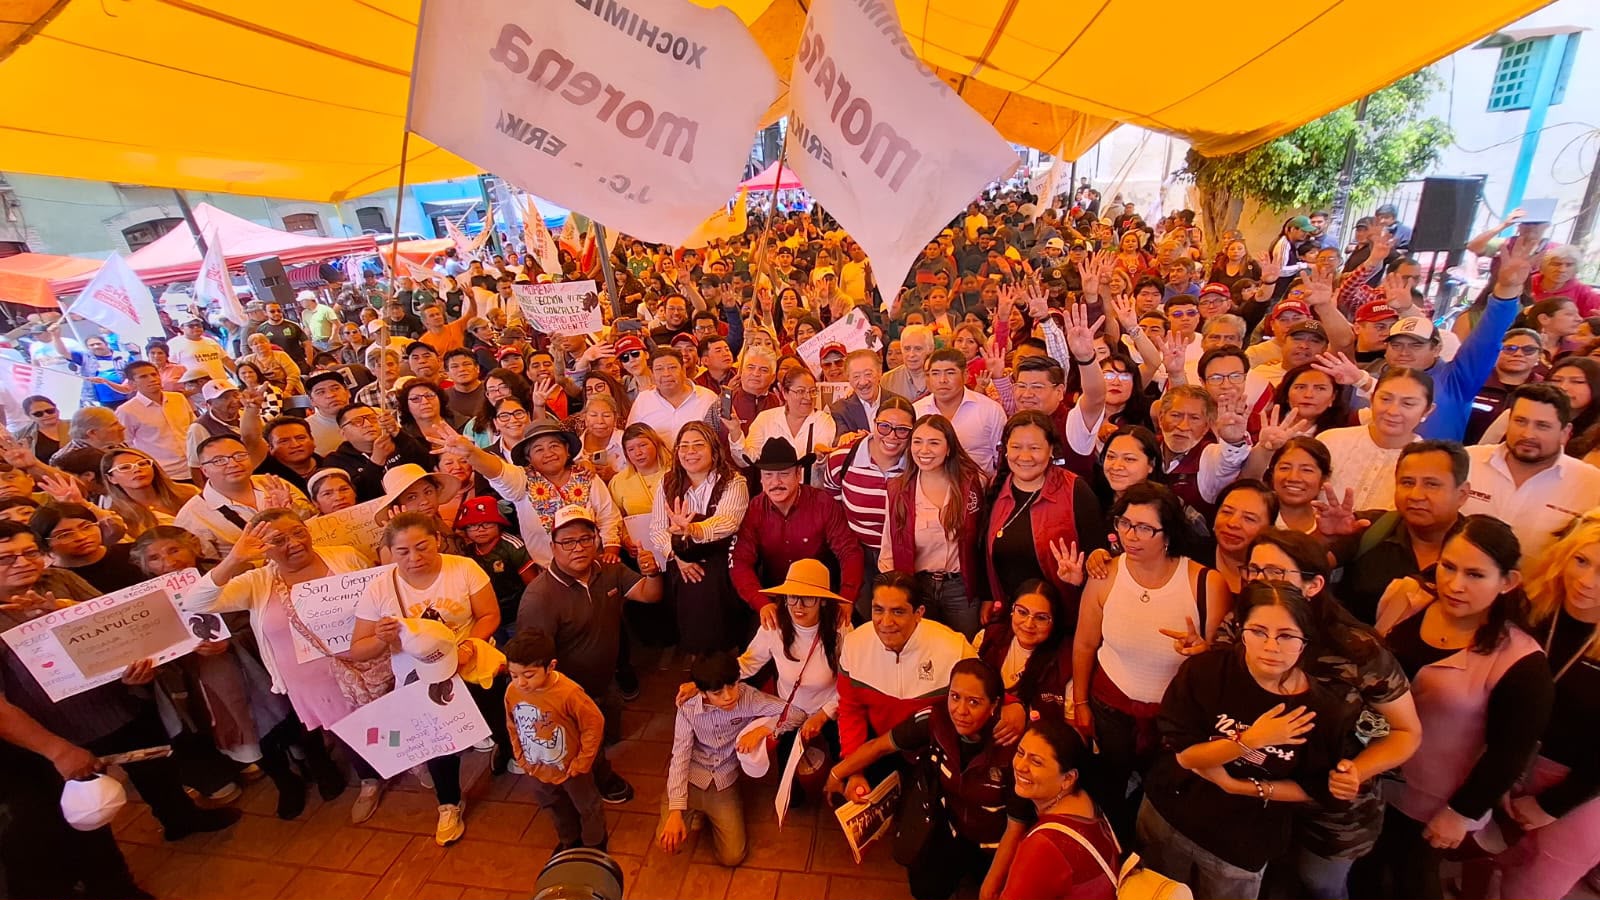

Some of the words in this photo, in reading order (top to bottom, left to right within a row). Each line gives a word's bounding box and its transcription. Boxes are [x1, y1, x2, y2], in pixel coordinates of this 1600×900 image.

[18, 596, 116, 635] morena
[164, 571, 198, 592] 4145
[298, 582, 329, 600] San
[67, 609, 152, 646] ATLAPULCO
